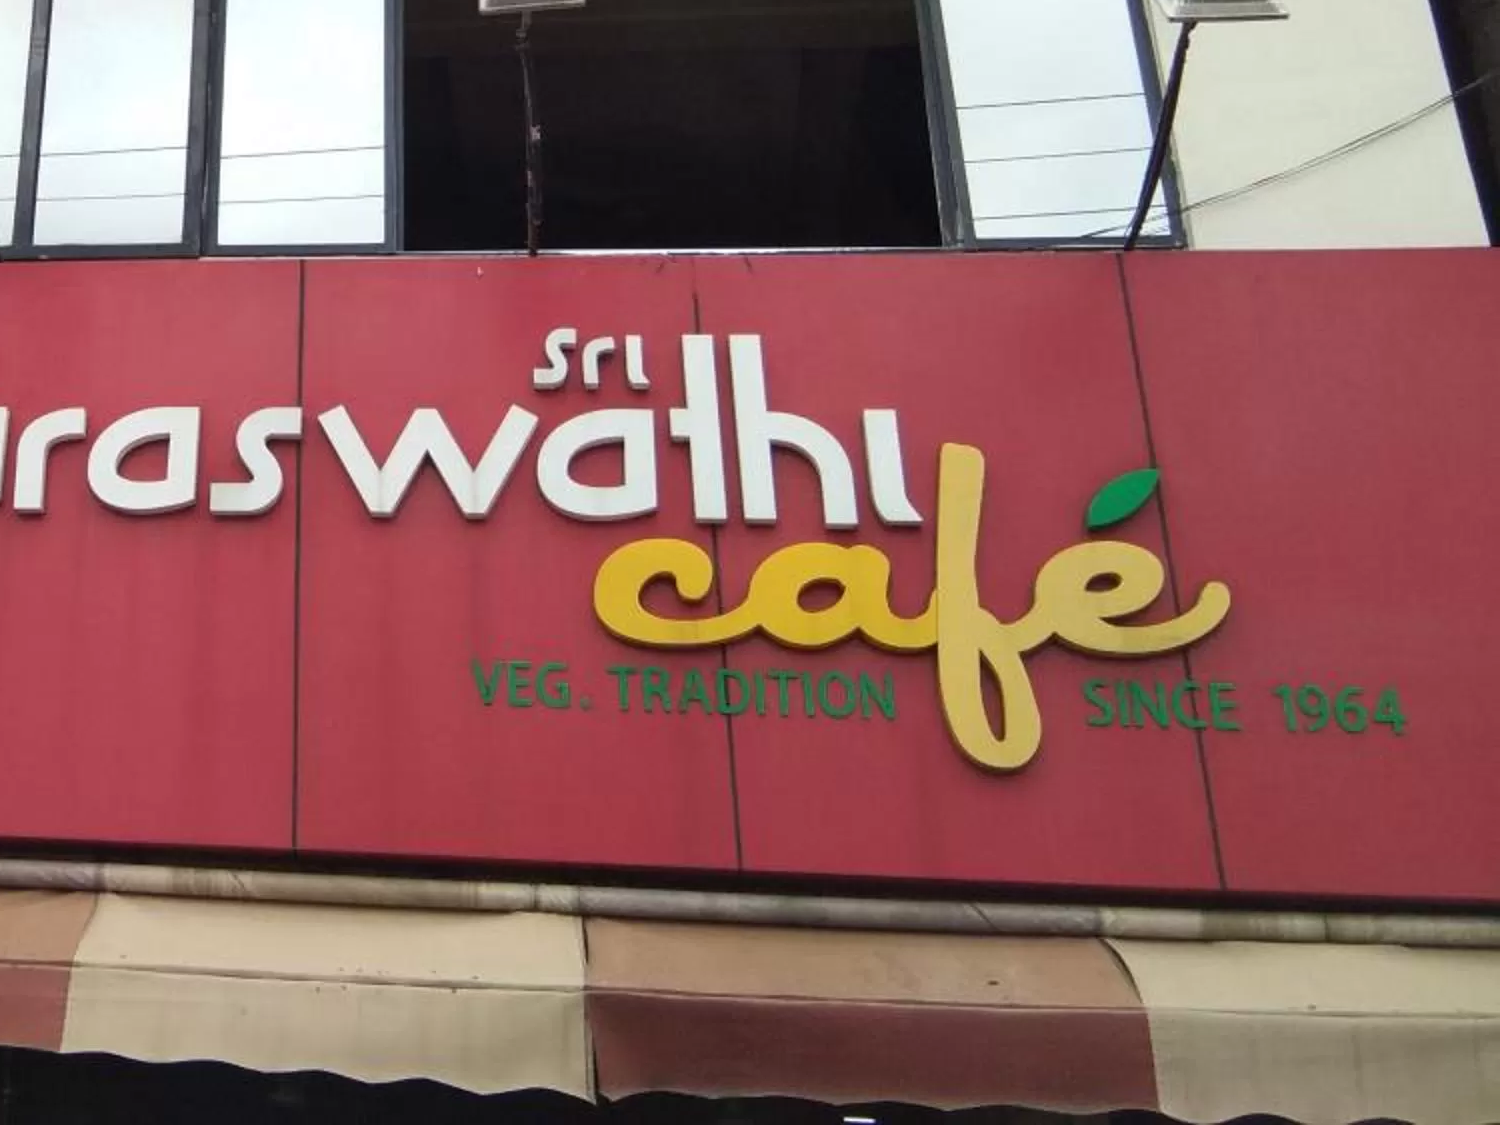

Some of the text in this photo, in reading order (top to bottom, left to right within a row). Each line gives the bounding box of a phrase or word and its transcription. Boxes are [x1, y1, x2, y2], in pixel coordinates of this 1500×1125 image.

[472, 660, 1408, 734] VEG. TRADITION SINCE 1964
